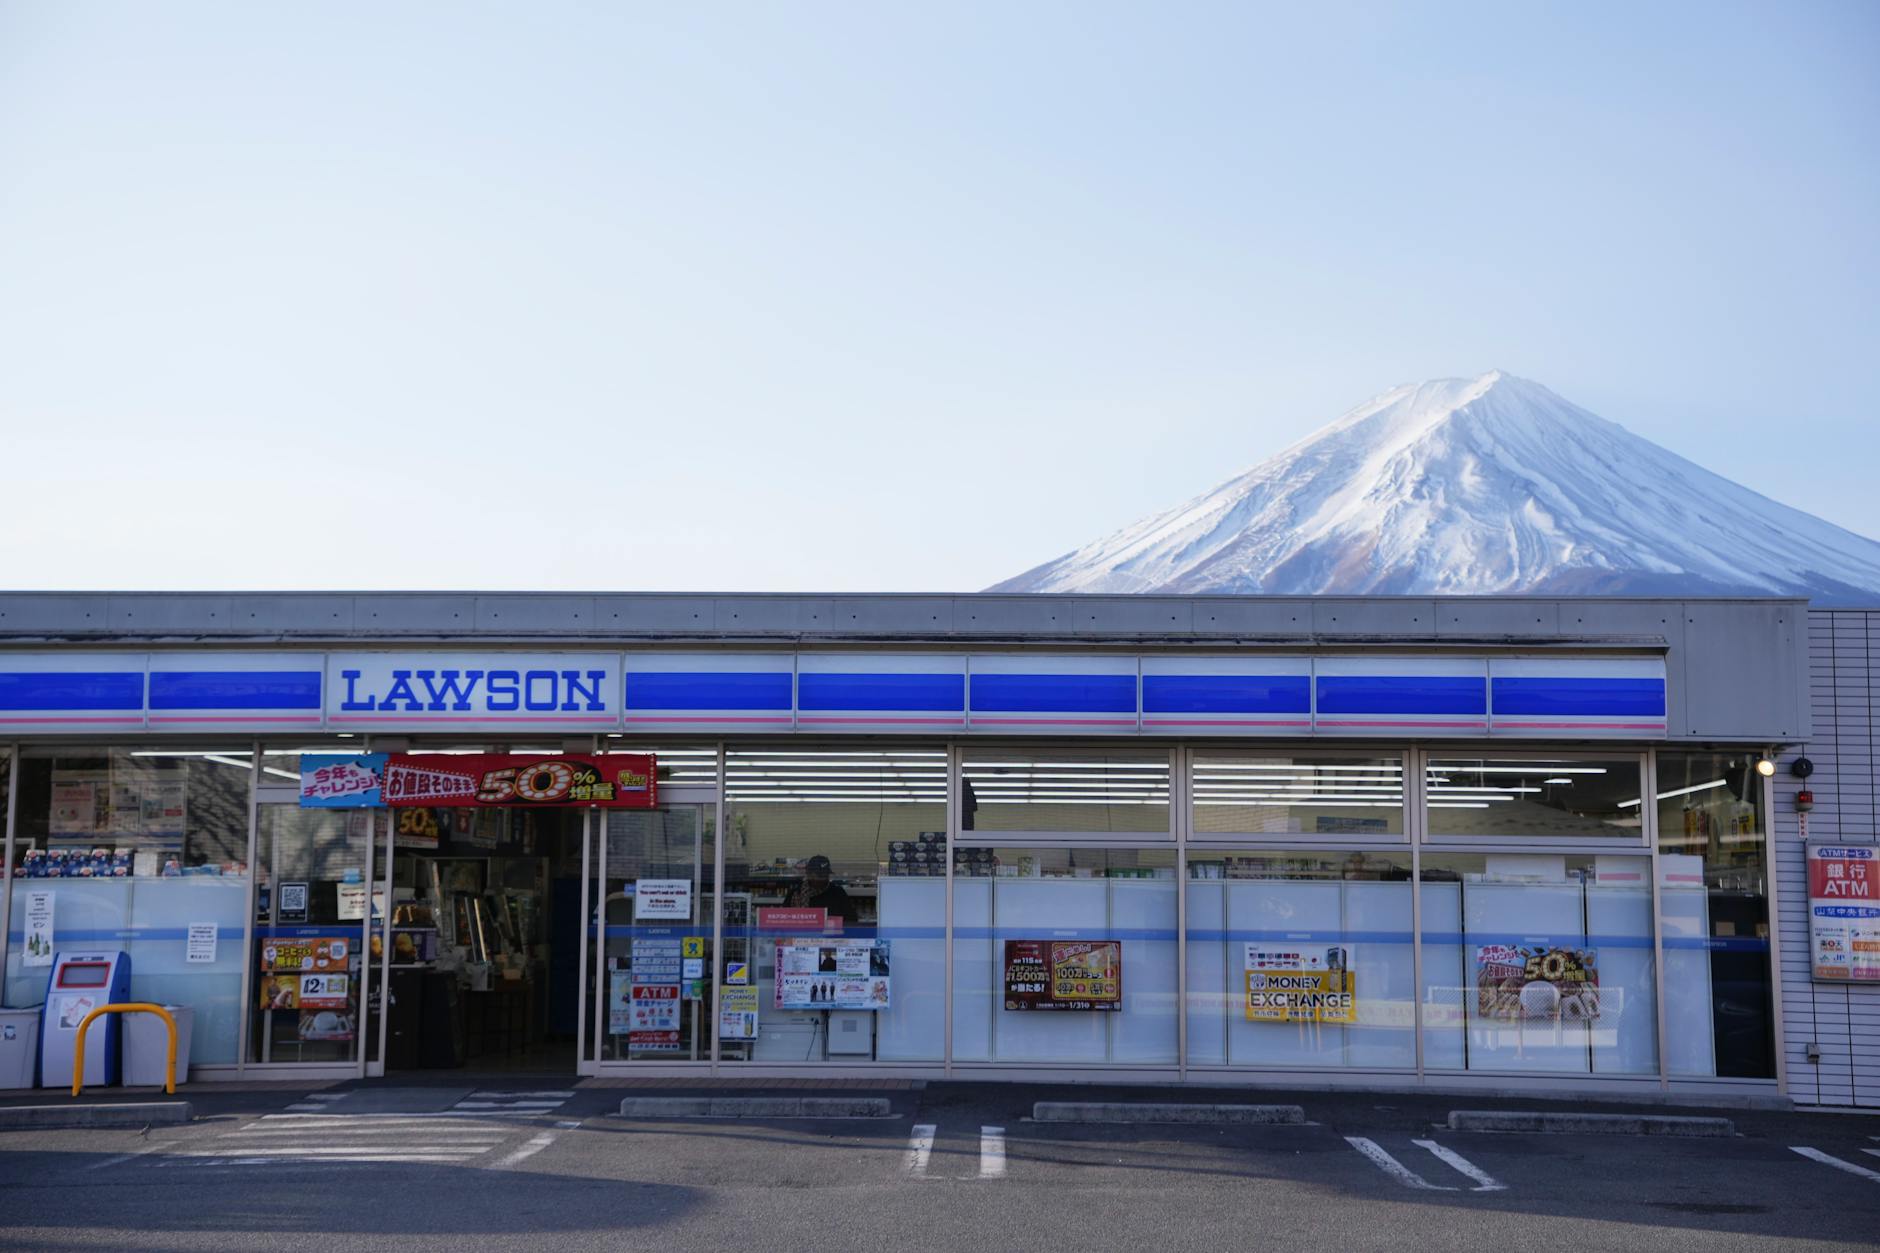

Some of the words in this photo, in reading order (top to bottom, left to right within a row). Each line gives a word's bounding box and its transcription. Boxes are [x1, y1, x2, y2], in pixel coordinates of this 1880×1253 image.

[341, 670, 606, 711] LAWSON
[314, 766, 359, 784] 今年も
[389, 769, 473, 797] お値段そのまま
[569, 782, 614, 801] 増量
[1820, 849, 1870, 858] ATMサービス
[1826, 863, 1866, 879] 銀行
[1823, 880, 1869, 896] ATM
[1268, 977, 1321, 989] MONEY
[640, 986, 672, 999] ATM
[1250, 993, 1351, 1008] EXCHANGE
